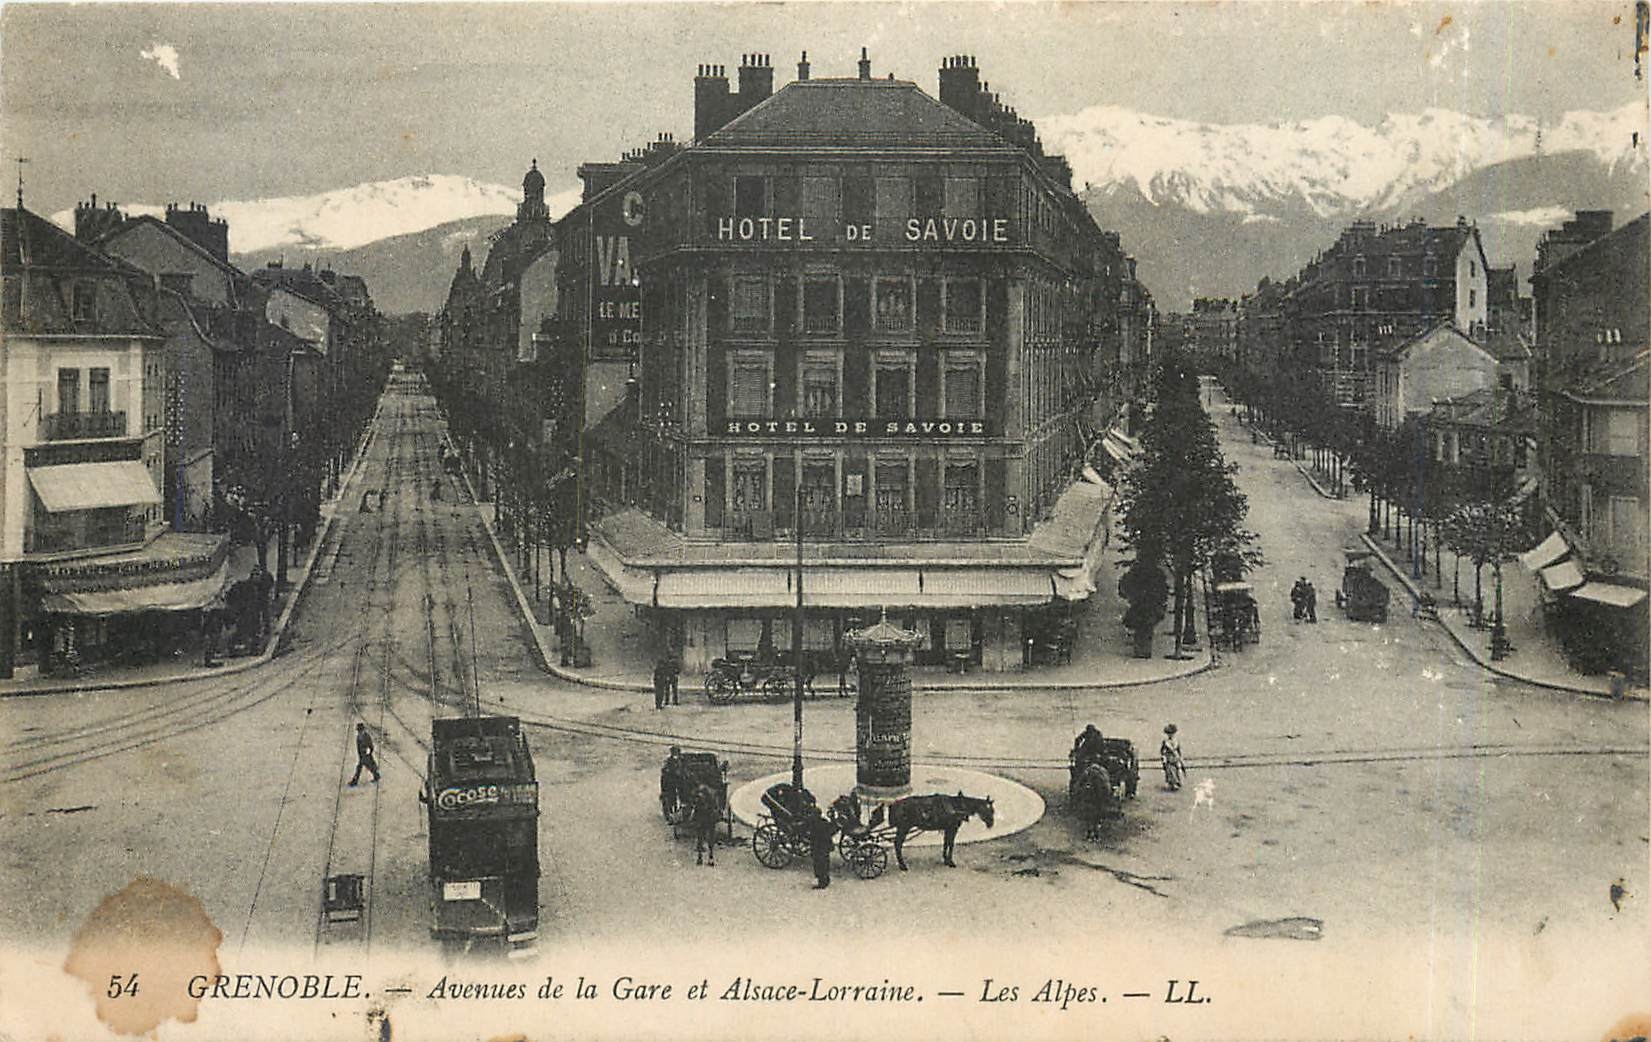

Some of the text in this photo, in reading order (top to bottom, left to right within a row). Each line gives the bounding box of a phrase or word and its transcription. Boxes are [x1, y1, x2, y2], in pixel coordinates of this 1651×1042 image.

[718, 217, 1008, 241] HOTEL DE SAVOIE
[599, 301, 614, 318] LE
[728, 421, 984, 434] HOTEL DE SAVOIE
